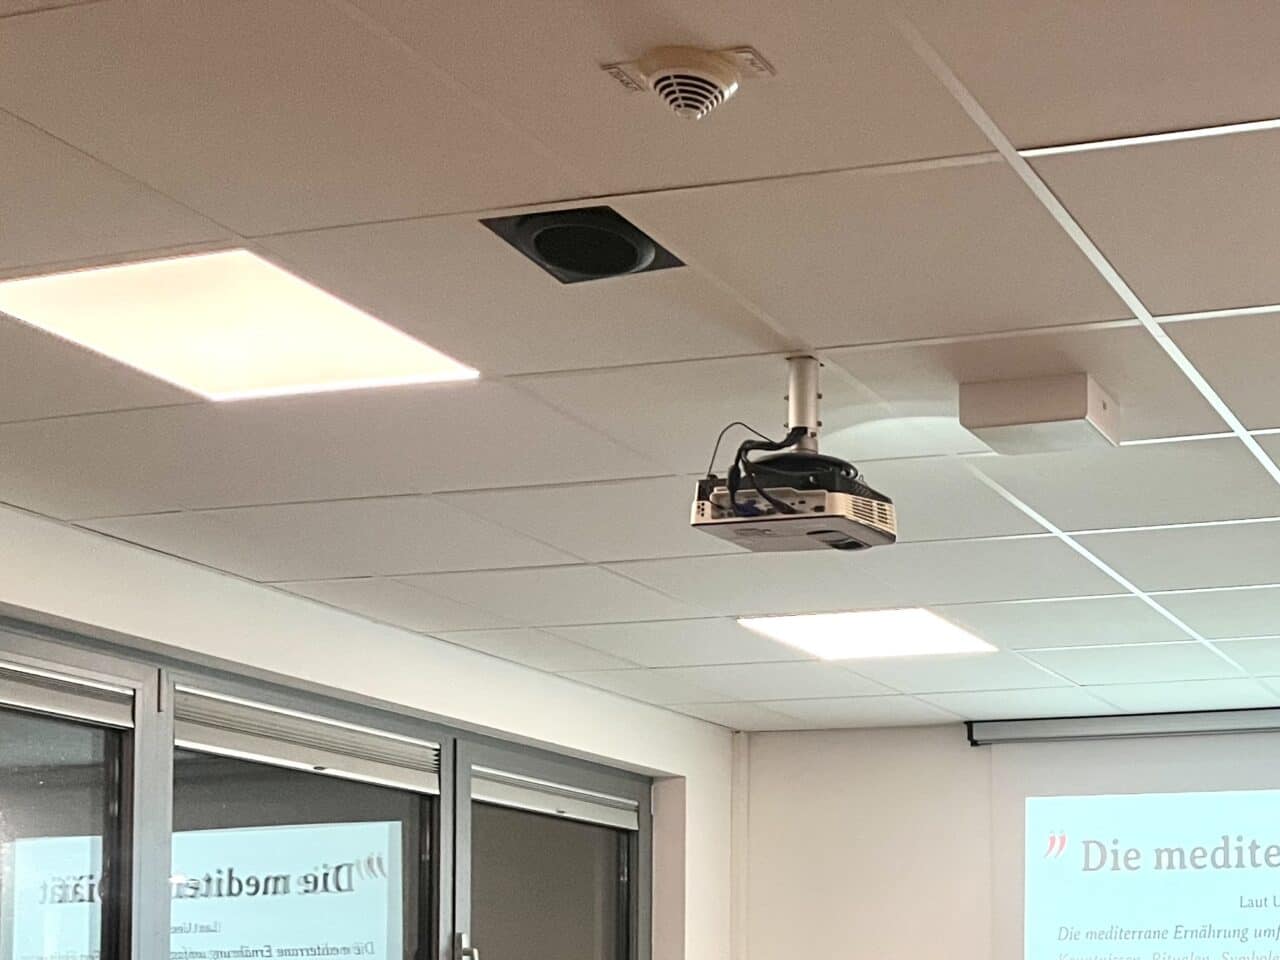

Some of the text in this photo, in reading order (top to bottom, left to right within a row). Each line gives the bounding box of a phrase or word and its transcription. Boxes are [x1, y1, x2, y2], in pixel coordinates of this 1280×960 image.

[1081, 837, 1142, 872] Die
[1239, 895, 1268, 909] Laut
[1057, 925, 1081, 941] Die
[1085, 924, 1169, 941] mediterrane
[1173, 923, 1250, 943] Ernährung
